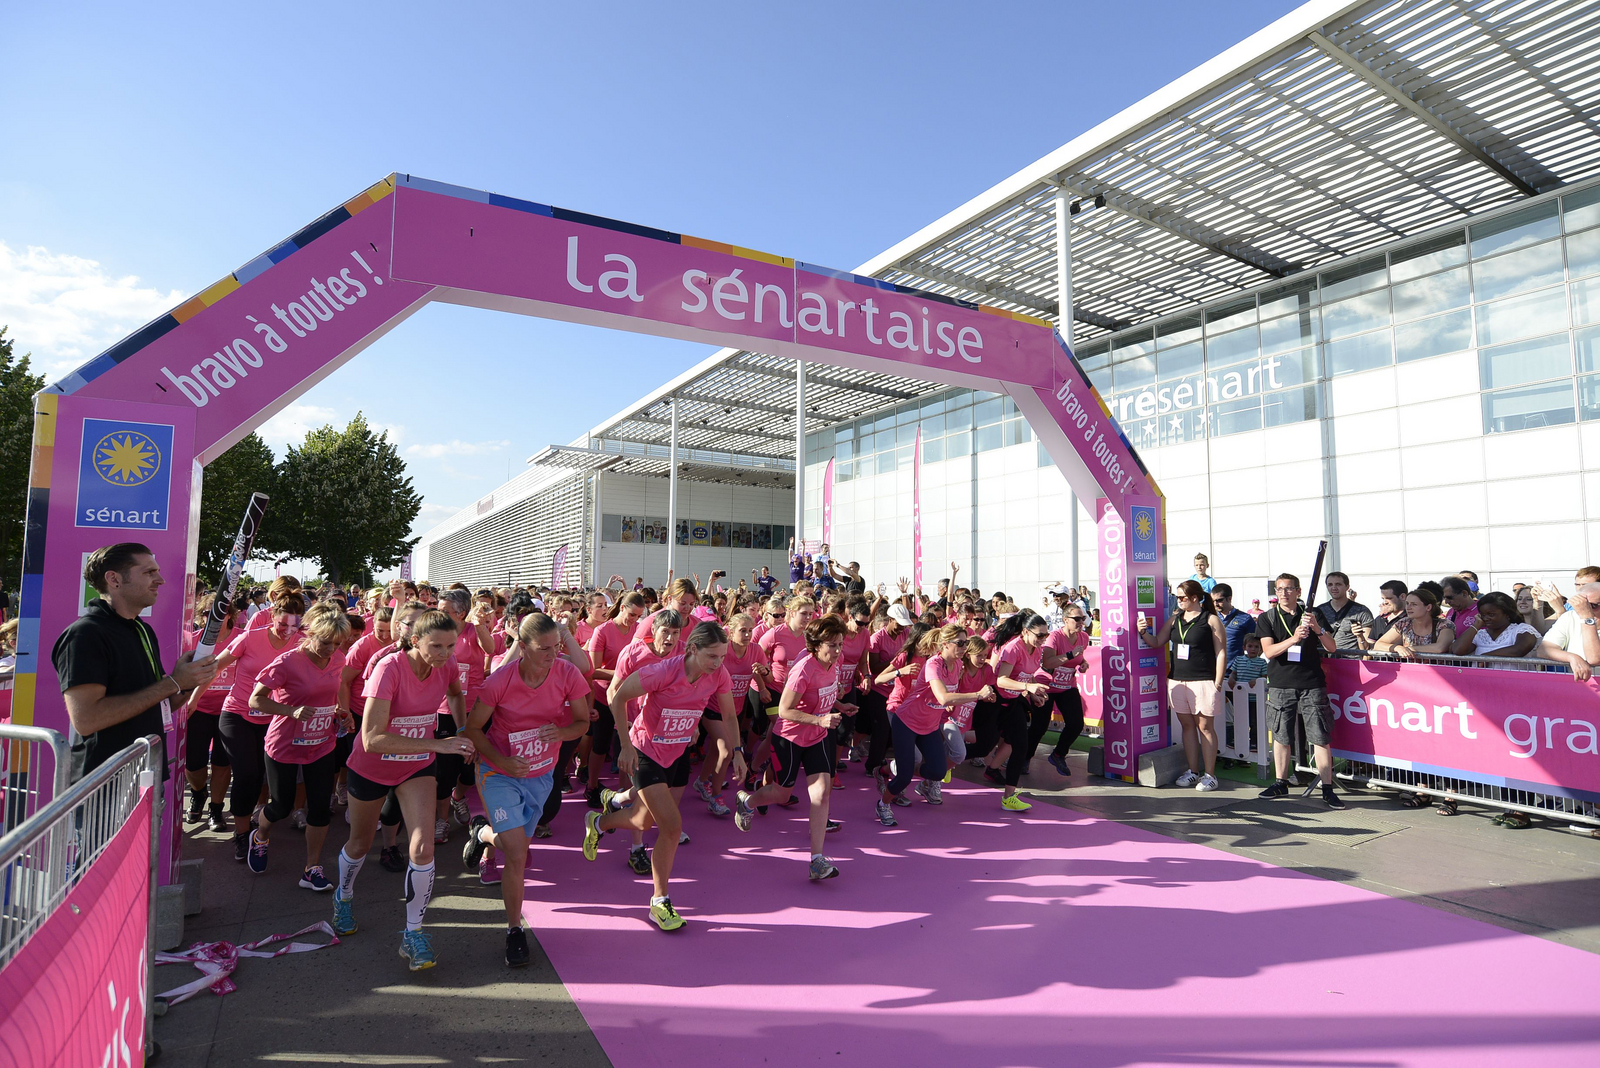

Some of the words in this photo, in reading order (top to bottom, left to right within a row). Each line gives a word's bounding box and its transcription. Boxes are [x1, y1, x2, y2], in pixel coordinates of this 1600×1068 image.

[681, 268, 984, 363] sénartaise
[160, 338, 264, 408] bravo
[245, 314, 288, 354] à
[270, 267, 367, 338] toutes
[350, 250, 383, 286] !
[1056, 378, 1088, 429] bravo
[1084, 420, 1098, 442] à
[1092, 433, 1125, 485] toutes
[1120, 475, 1133, 493] !
[85, 507, 160, 525] sénart
[1134, 551, 1156, 560] sénart
[1138, 586, 1155, 595] sénart
[301, 716, 332, 732] 1450
[1327, 690, 1477, 740] sénart
[663, 717, 695, 732] 1380
